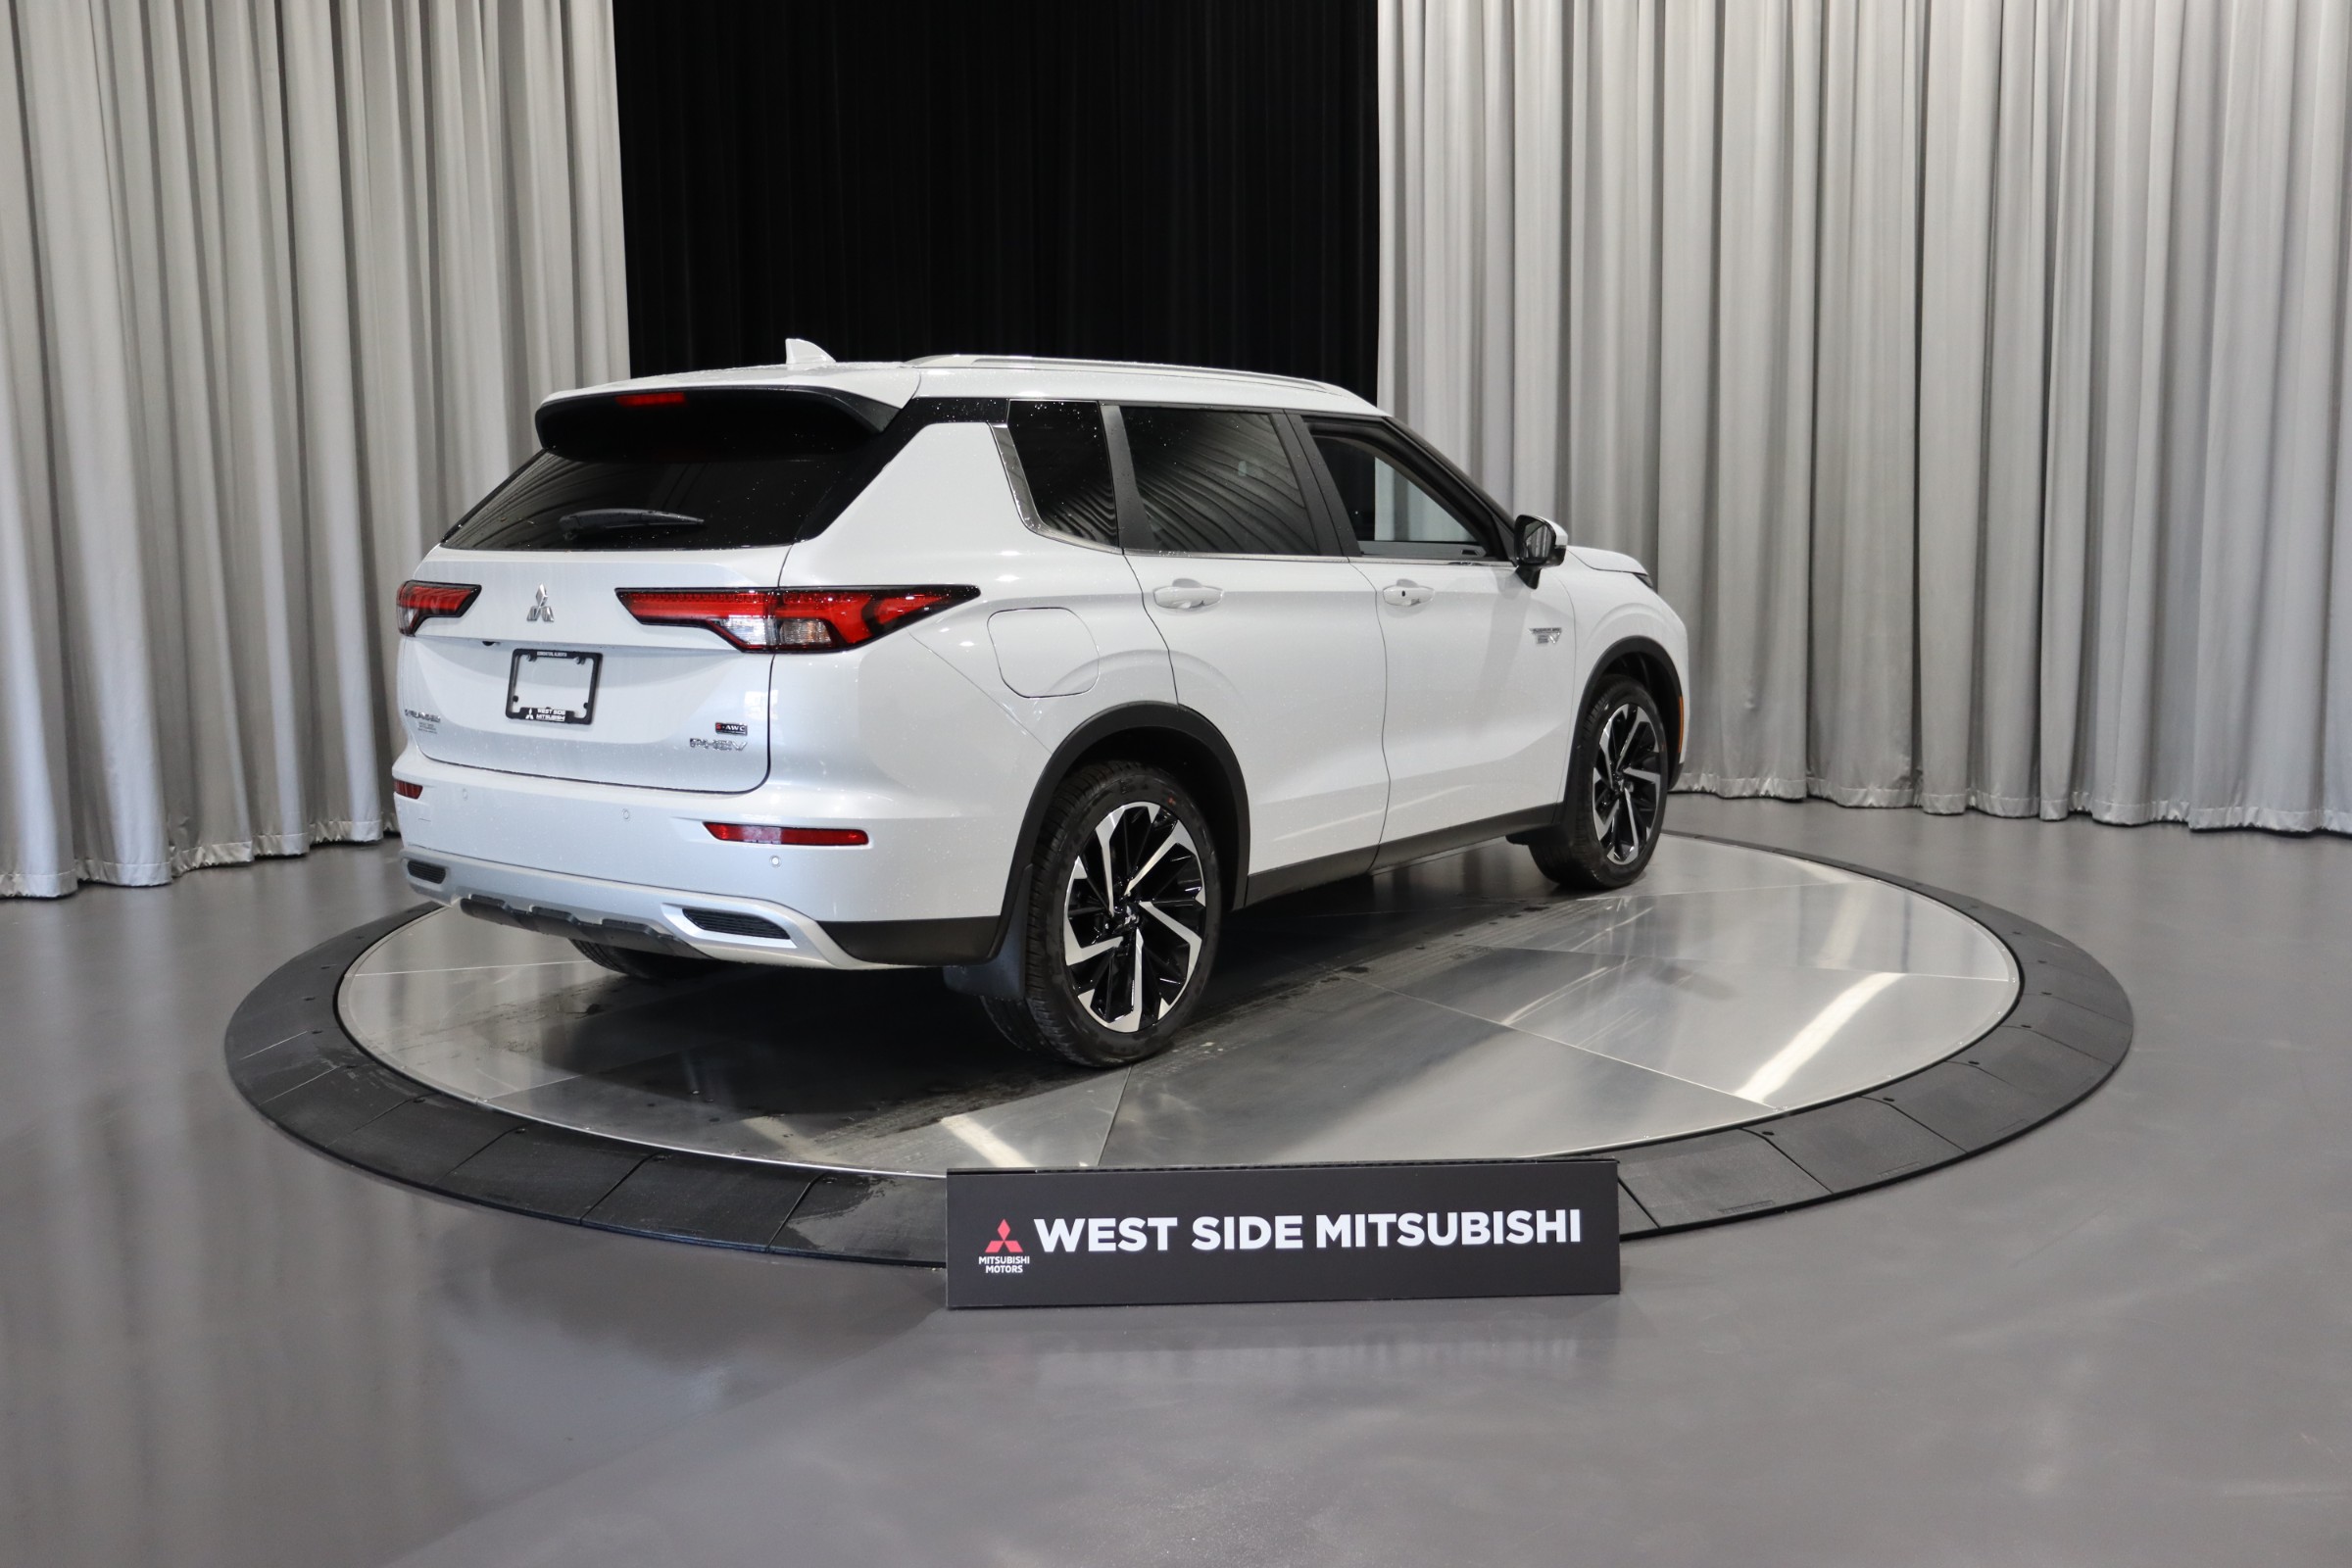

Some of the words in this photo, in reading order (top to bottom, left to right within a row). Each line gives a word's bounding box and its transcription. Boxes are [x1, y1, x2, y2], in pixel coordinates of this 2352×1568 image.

[1034, 1217, 1178, 1252] WEST
[1192, 1215, 1303, 1250] SIDE
[1316, 1208, 1581, 1249] MITSUBISHI
[978, 1255, 1030, 1264] MITSUBISHI
[985, 1264, 1023, 1273] MOTORS
